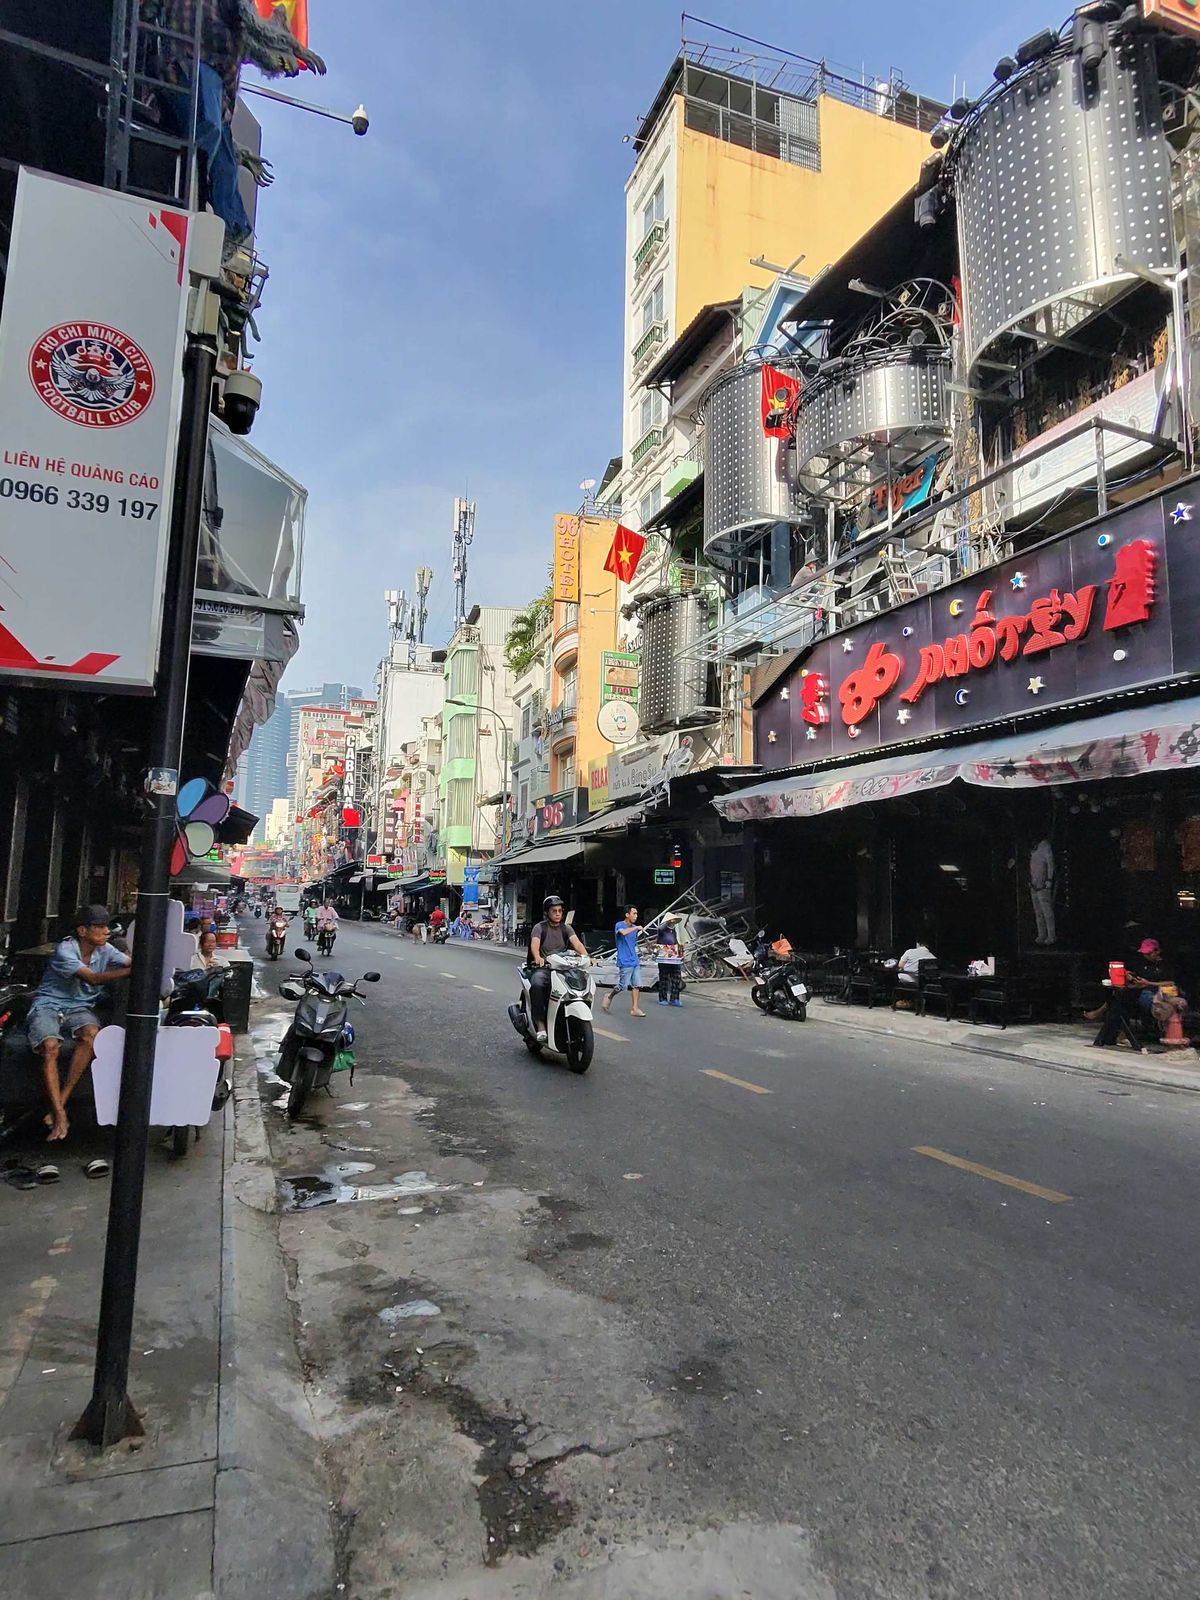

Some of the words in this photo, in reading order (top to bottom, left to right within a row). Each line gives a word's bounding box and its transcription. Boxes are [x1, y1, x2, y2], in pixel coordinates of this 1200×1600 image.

[40, 336, 59, 353] HO
[57, 325, 83, 340] CHI
[87, 325, 125, 347] MINH
[124, 345, 149, 373] CITY
[38, 381, 105, 425] FOOTBALL
[109, 399, 142, 423] CLUB
[4, 450, 40, 469] LIÊN
[45, 457, 66, 476] HỆ
[70, 463, 124, 484] QUẢNG
[129, 471, 159, 490] CÁO
[0, 477, 59, 506] 0966
[66, 489, 110, 514] 339
[118, 498, 158, 521] 197
[560, 537, 575, 599] HOTEL
[838, 642, 901, 725] 86
[344, 734, 356, 809] CABANA
[542, 801, 564, 829] 96
